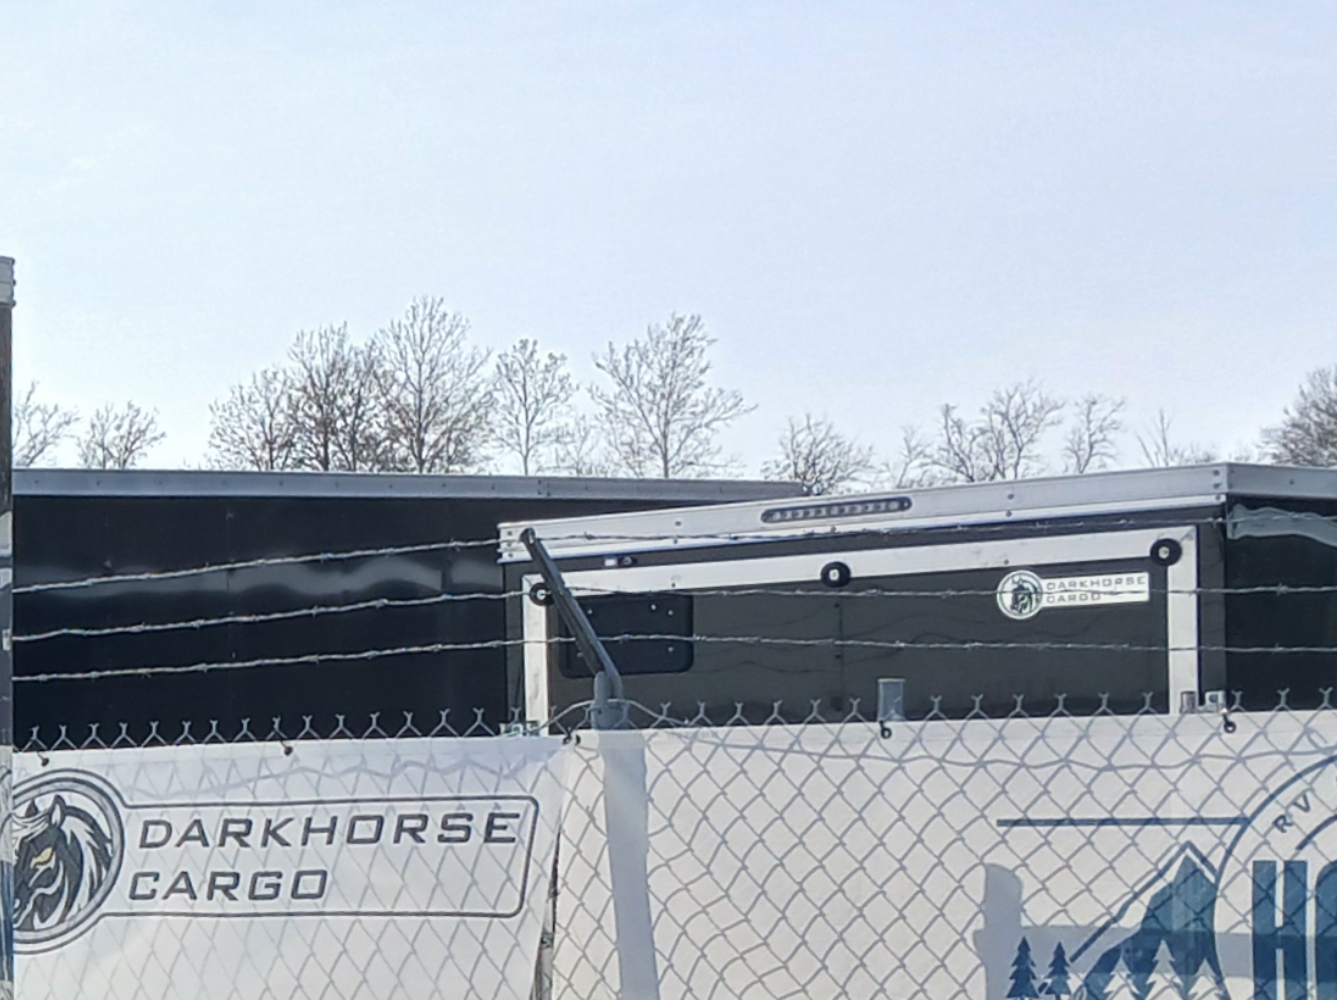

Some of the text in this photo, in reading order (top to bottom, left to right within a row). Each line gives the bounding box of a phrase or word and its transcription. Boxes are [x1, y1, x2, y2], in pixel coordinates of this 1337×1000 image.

[1046, 575, 1146, 591] DARKHORSE
[1272, 793, 1311, 834] RV
[138, 813, 520, 849] DARKHORSE
[128, 868, 328, 901] CARGO
